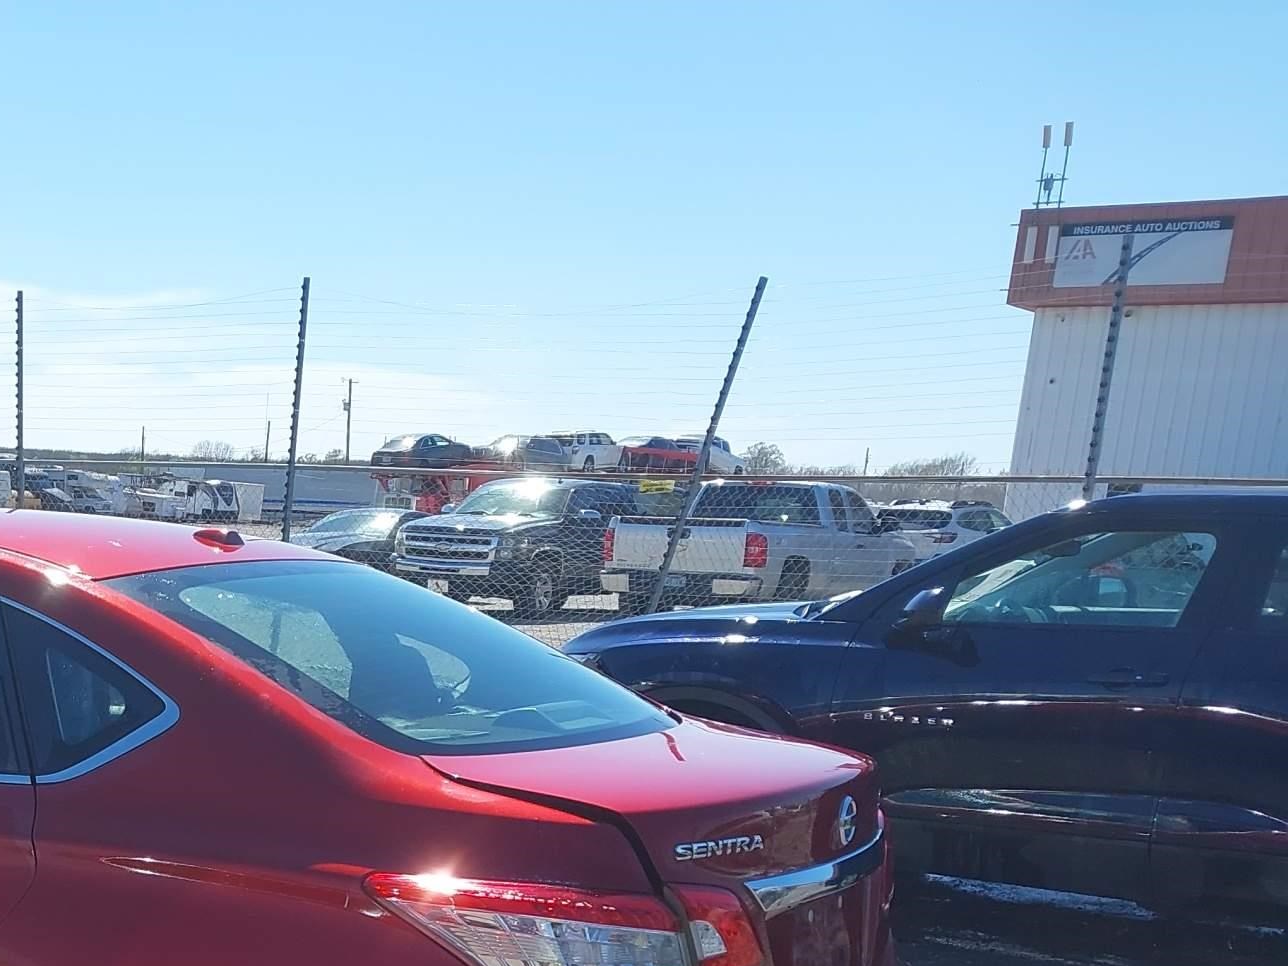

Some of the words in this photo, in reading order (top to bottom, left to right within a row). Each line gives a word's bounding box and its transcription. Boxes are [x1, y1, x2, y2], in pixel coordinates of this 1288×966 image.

[1073, 224, 1132, 235] INSURANCE
[1135, 222, 1163, 233] AUTO
[1165, 220, 1221, 232] AUCTIONS
[674, 834, 765, 861] SENTRA
